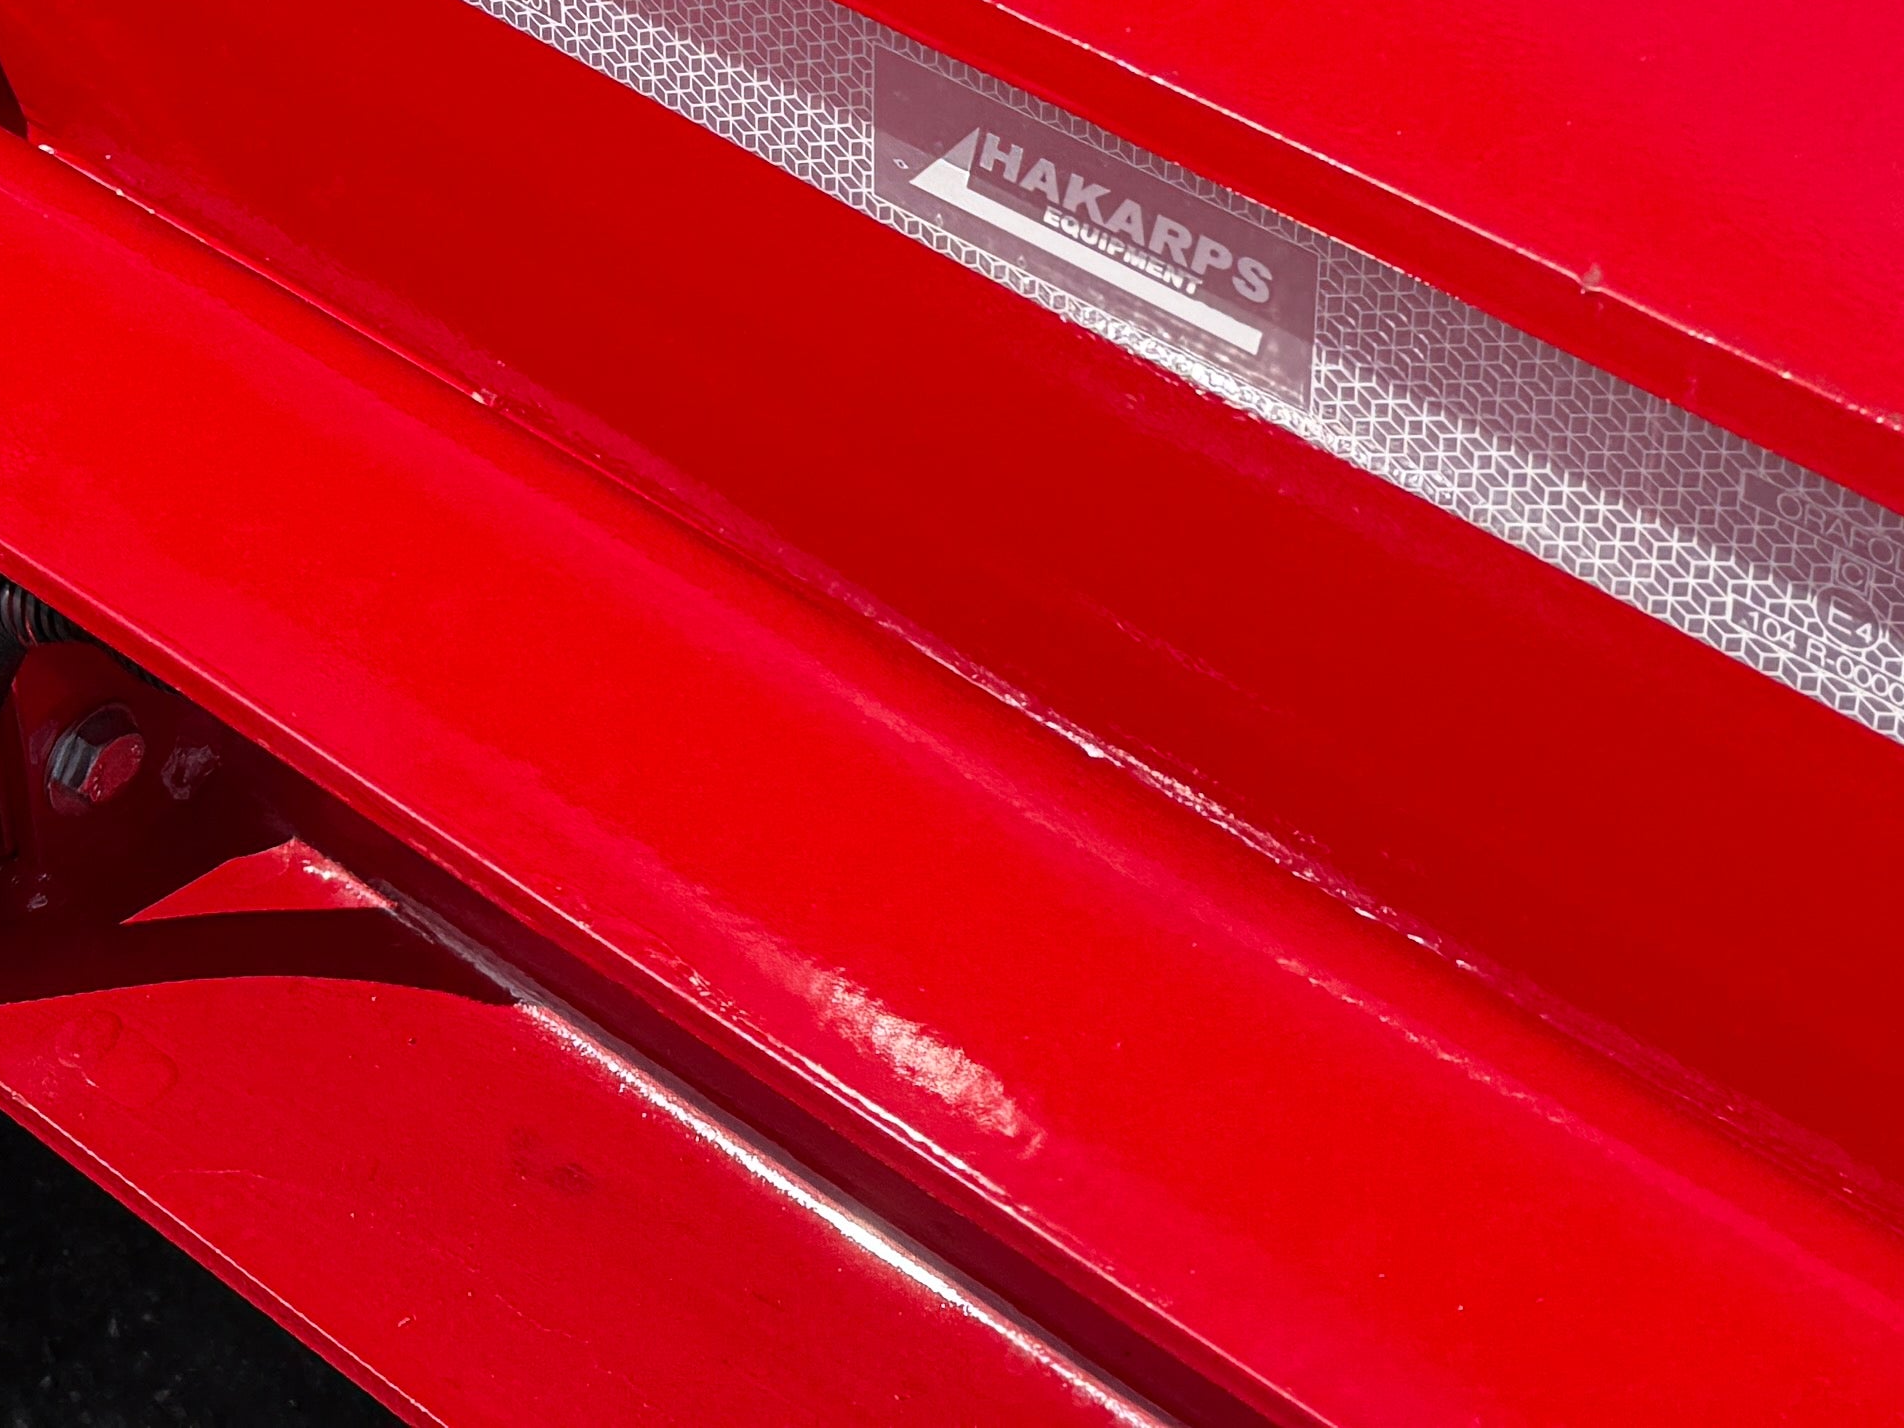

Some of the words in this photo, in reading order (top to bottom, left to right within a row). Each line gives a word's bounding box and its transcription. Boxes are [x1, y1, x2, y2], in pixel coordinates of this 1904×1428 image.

[979, 130, 1274, 306] HAKARPS
[1042, 204, 1203, 296] EQUIPMENT
[1748, 610, 1797, 651] 104
[1828, 595, 1874, 644] E4
